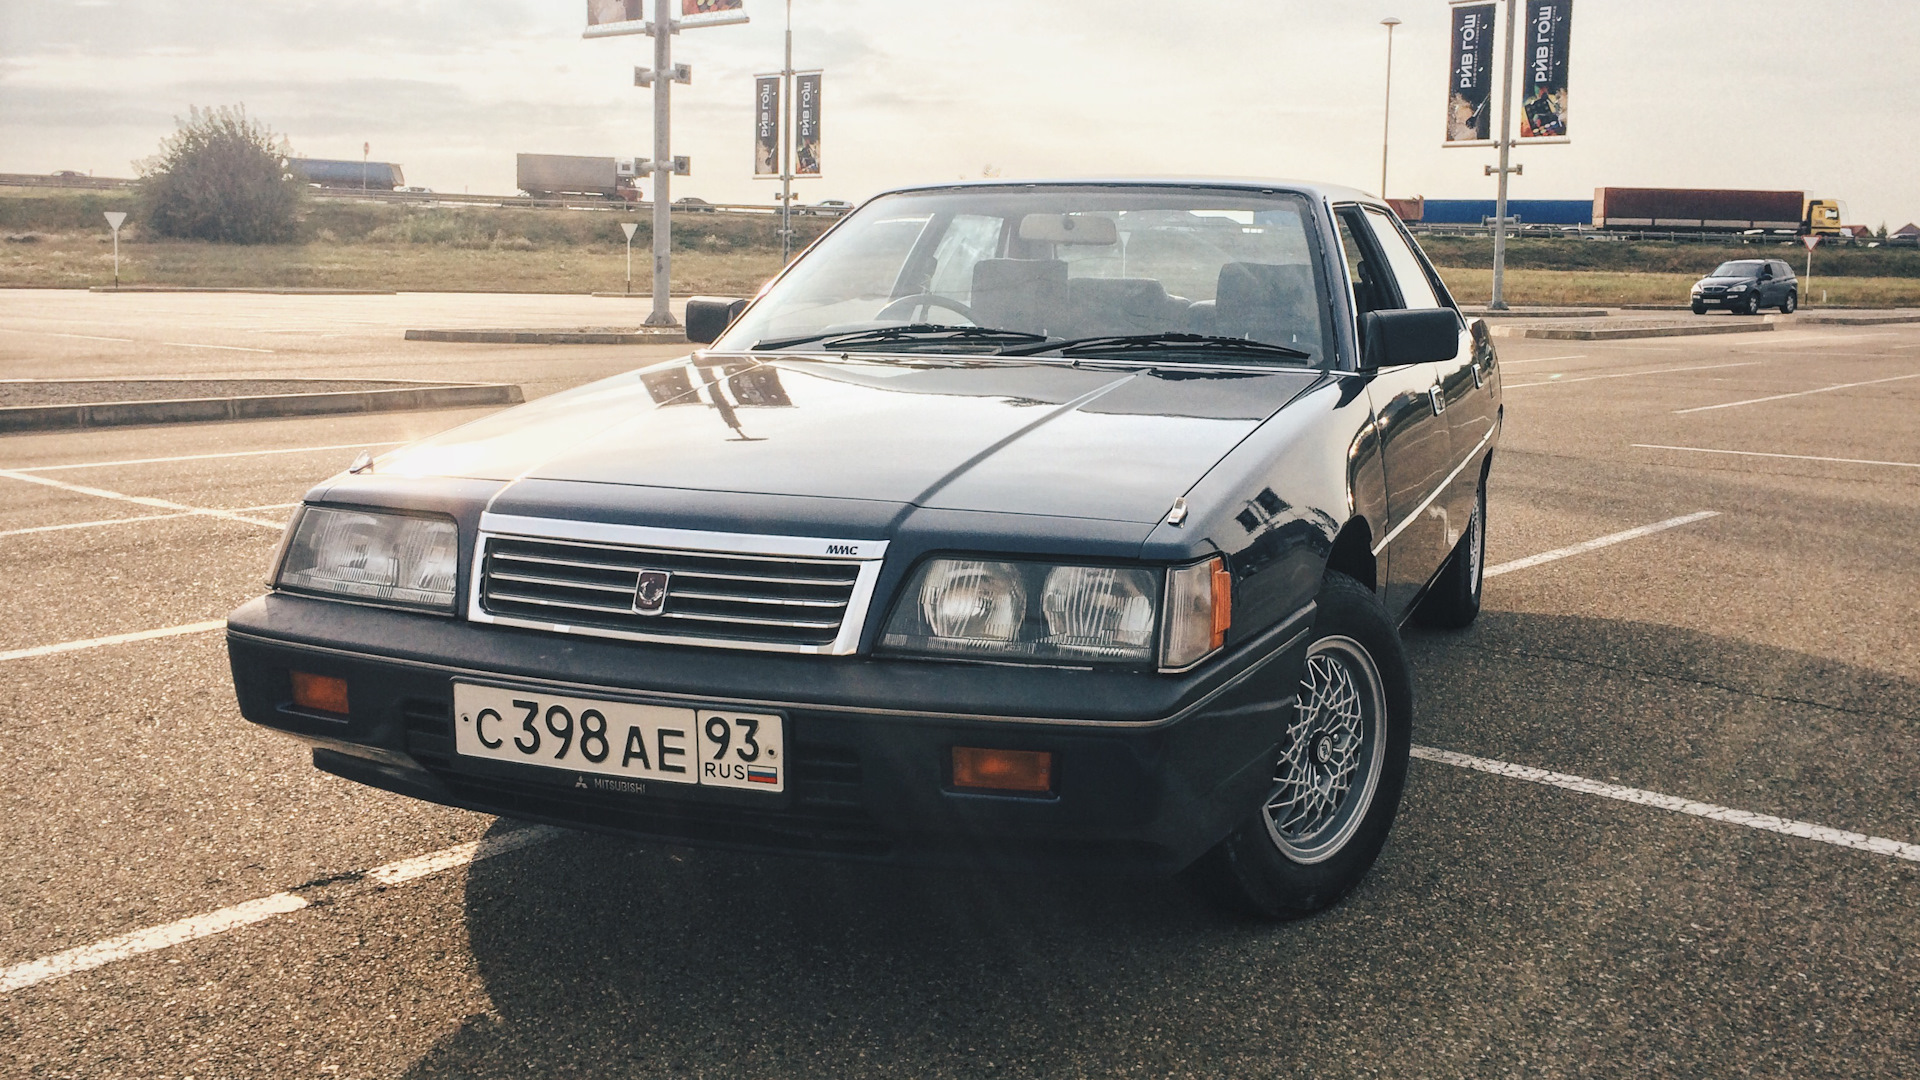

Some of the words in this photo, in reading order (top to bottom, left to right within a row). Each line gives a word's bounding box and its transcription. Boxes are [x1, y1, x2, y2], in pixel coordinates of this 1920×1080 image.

[1462, 14, 1477, 50] ГОШ
[1537, 6, 1552, 43] ГОШ
[1460, 53, 1473, 88] РИВ
[1535, 46, 1549, 82] РИВ
[826, 545, 858, 555] MMC
[705, 716, 760, 762] 93
[594, 778, 646, 794] MITSUBISHI
[705, 762, 746, 780] RUS
